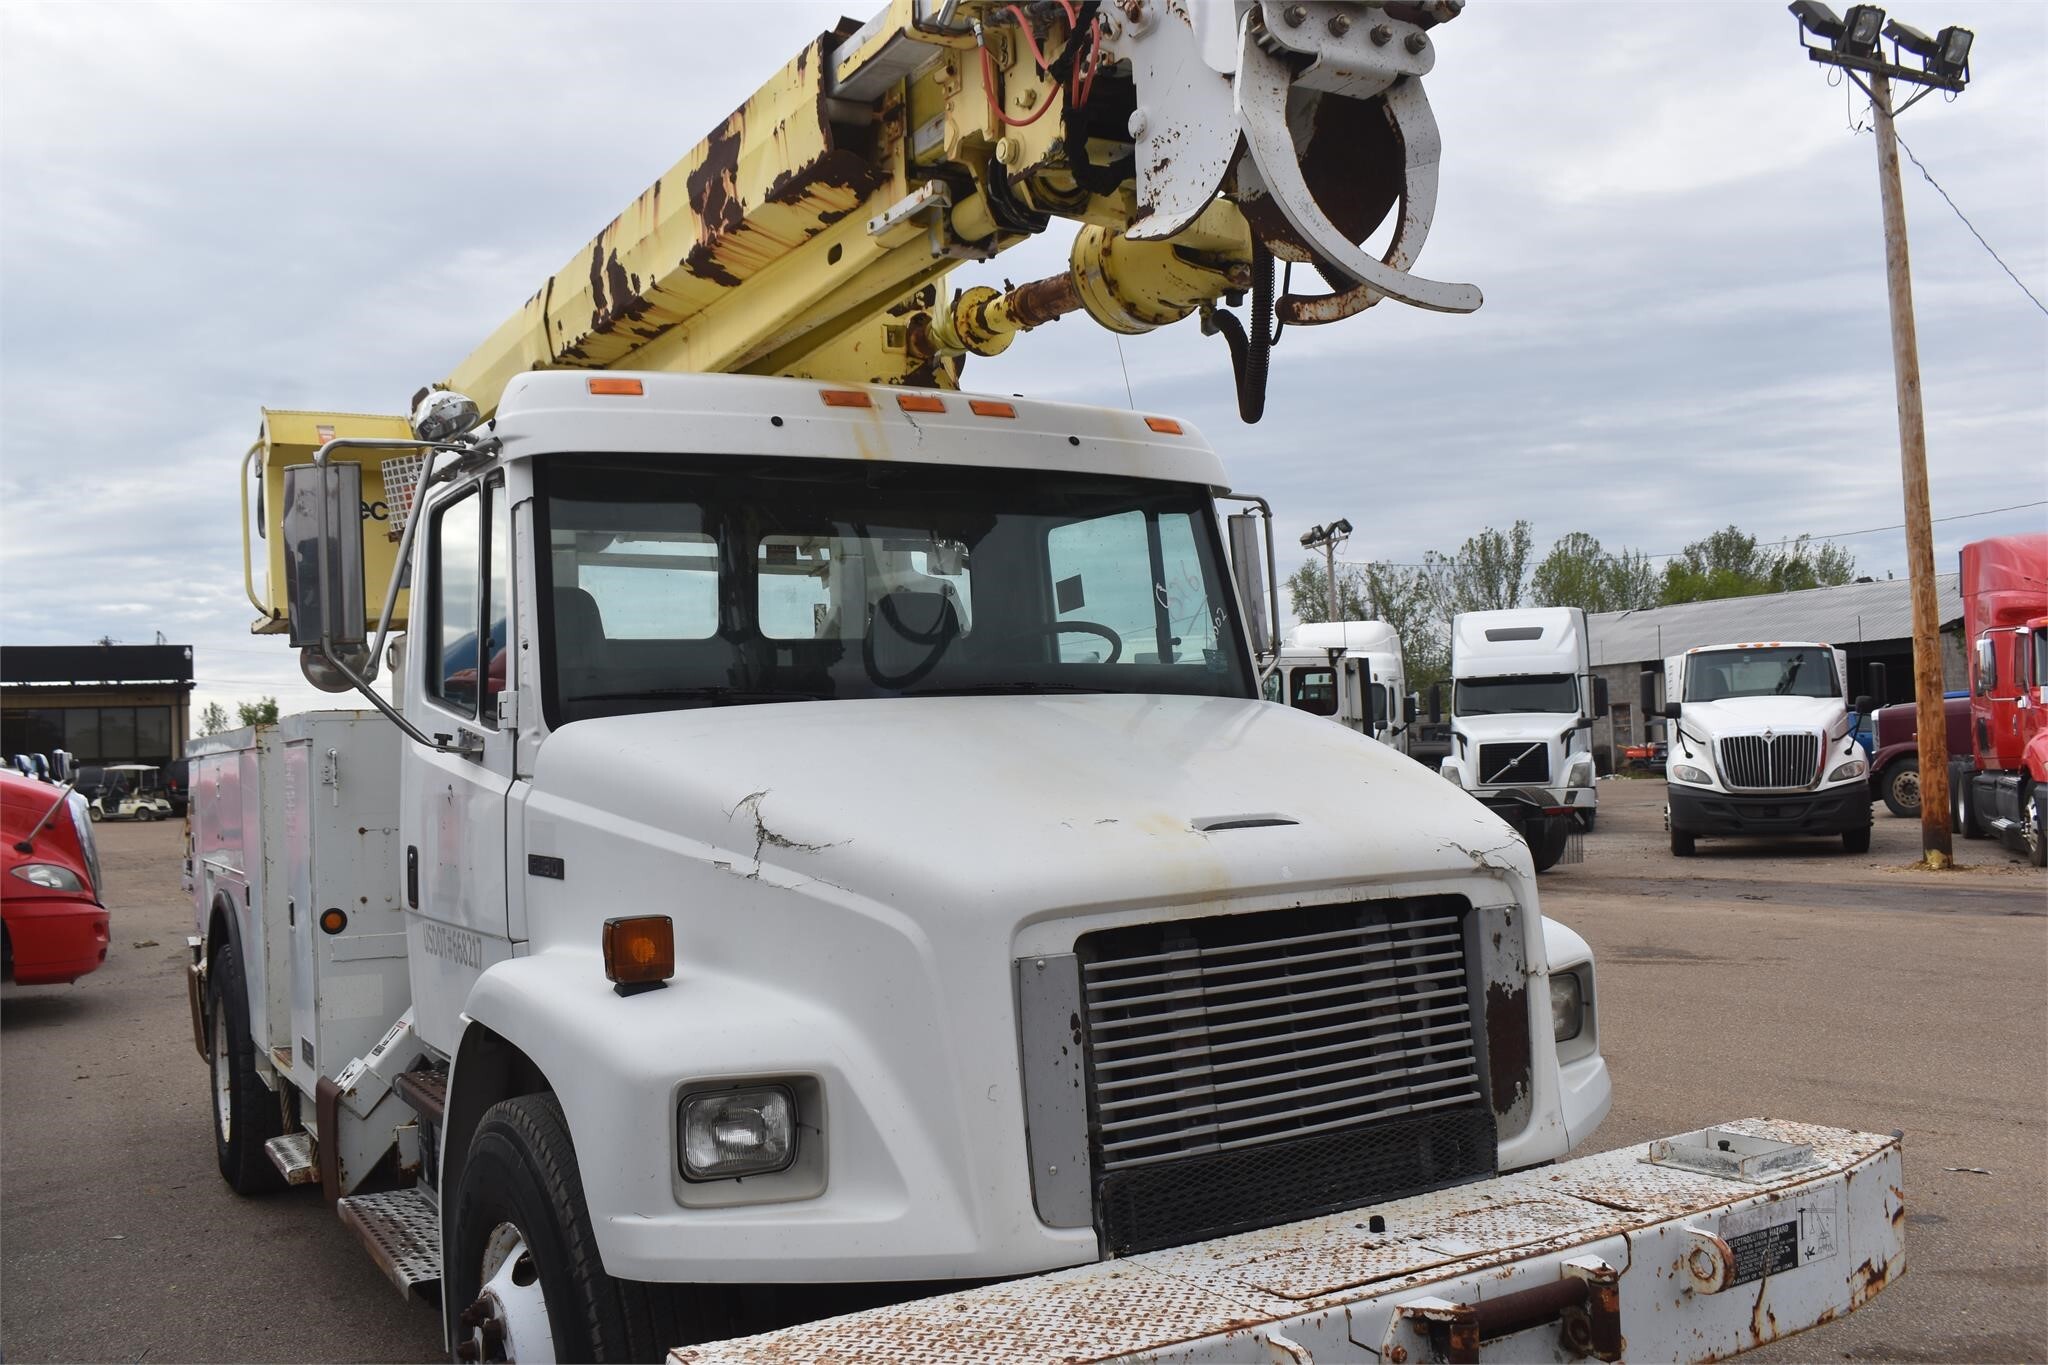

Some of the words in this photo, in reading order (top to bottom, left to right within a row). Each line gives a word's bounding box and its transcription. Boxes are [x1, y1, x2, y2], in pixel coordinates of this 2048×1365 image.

[422, 922, 482, 969] USDOT#668217
[1728, 1231, 1768, 1247] ELECTROCUTION
[1769, 1224, 1789, 1236] HAZARD
